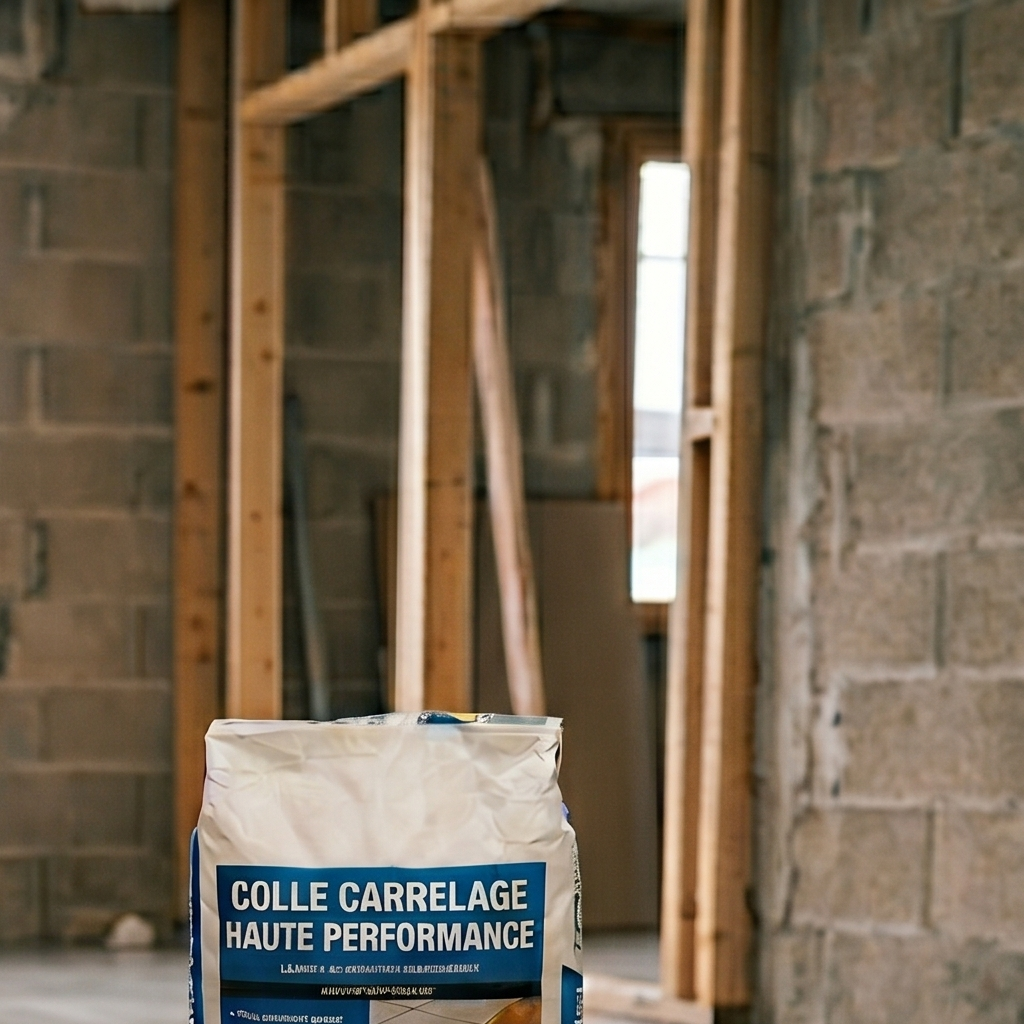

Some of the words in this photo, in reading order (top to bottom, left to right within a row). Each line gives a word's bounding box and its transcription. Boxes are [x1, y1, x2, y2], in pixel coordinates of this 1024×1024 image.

[230, 880, 329, 911] COLLE
[338, 879, 529, 912] CARRELAGE
[225, 921, 314, 951] HAUTE
[323, 920, 535, 952] PERFORMANCE
